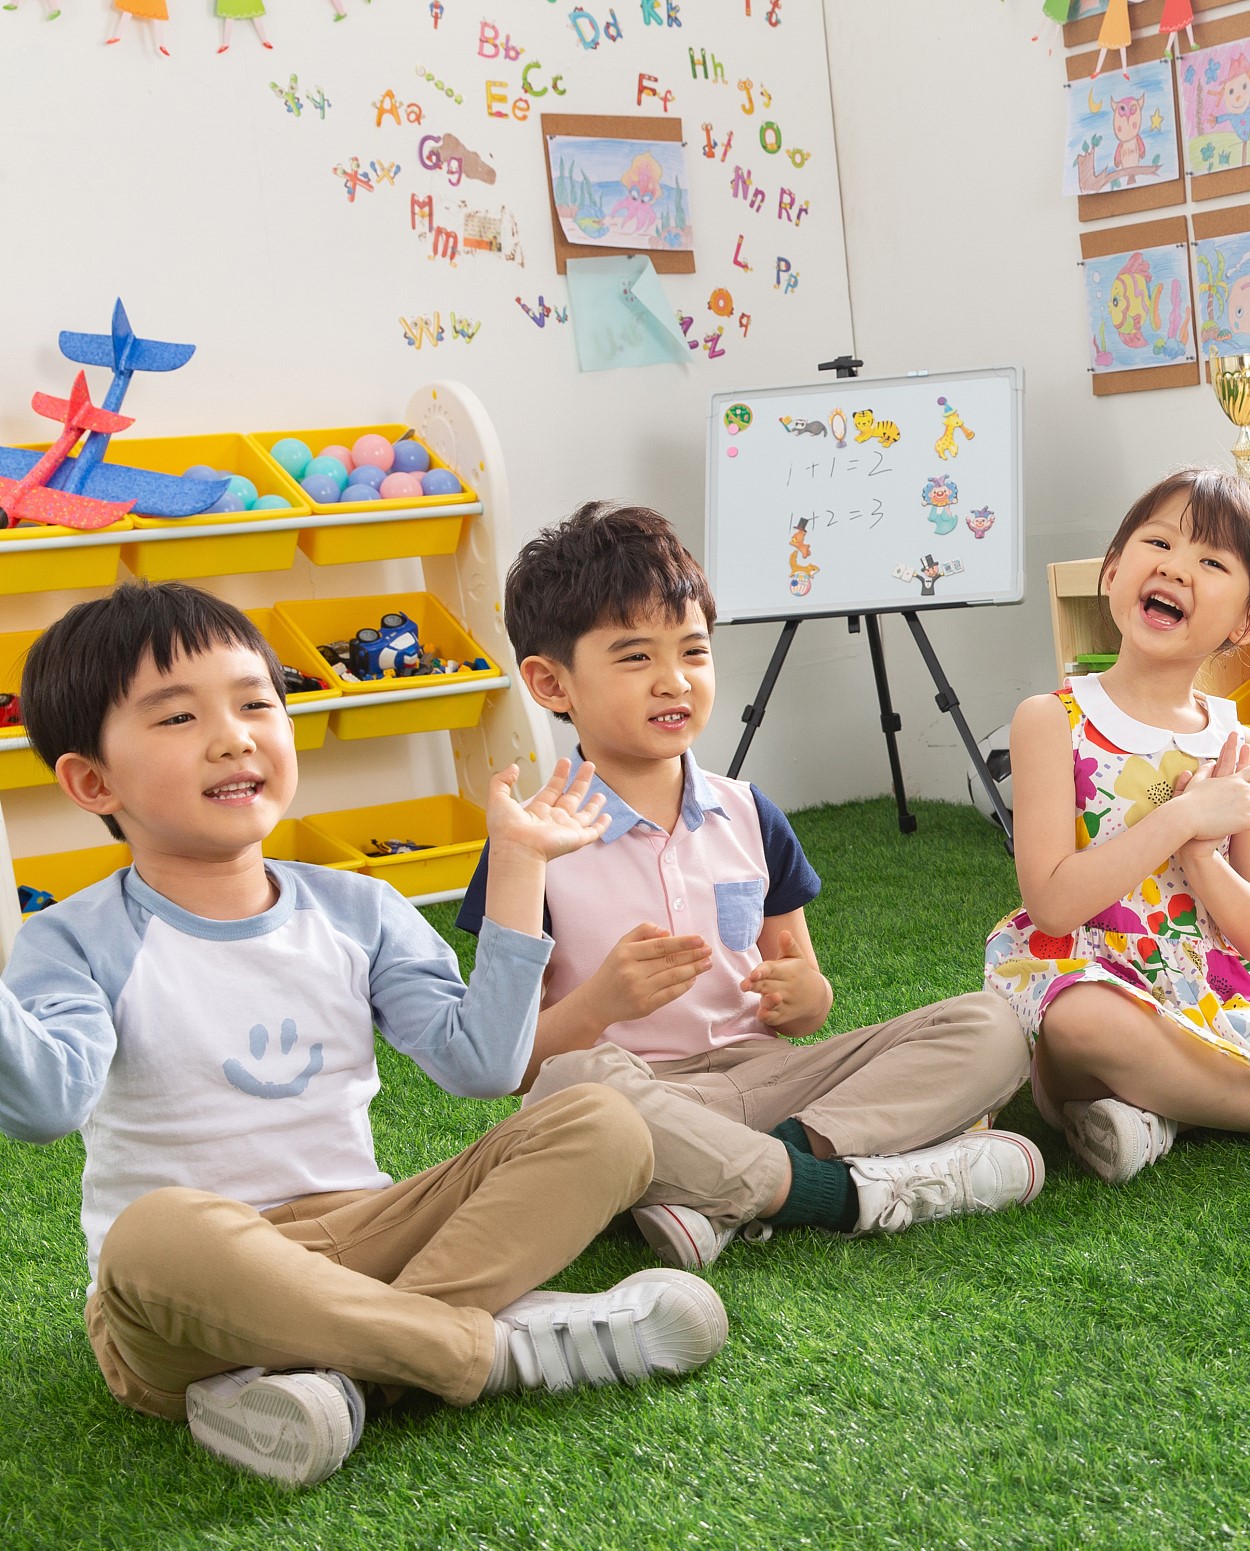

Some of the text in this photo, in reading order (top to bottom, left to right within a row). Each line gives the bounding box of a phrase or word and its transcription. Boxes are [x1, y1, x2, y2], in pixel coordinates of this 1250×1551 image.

[478, 20, 522, 61] Bb
[568, 7, 623, 50] Dd
[521, 61, 566, 97] Cc
[689, 47, 728, 84] Hh
[269, 74, 330, 119] Yy
[374, 89, 424, 127] Aa
[485, 80, 530, 121] Ee
[637, 73, 675, 112] Ff
[738, 79, 771, 115] Jj
[332, 156, 400, 202] Xx
[418, 135, 463, 186] Gg
[731, 165, 766, 213] Nn
[777, 187, 809, 227] Rr
[410, 193, 458, 263] Mm
[399, 311, 481, 349] Ww
